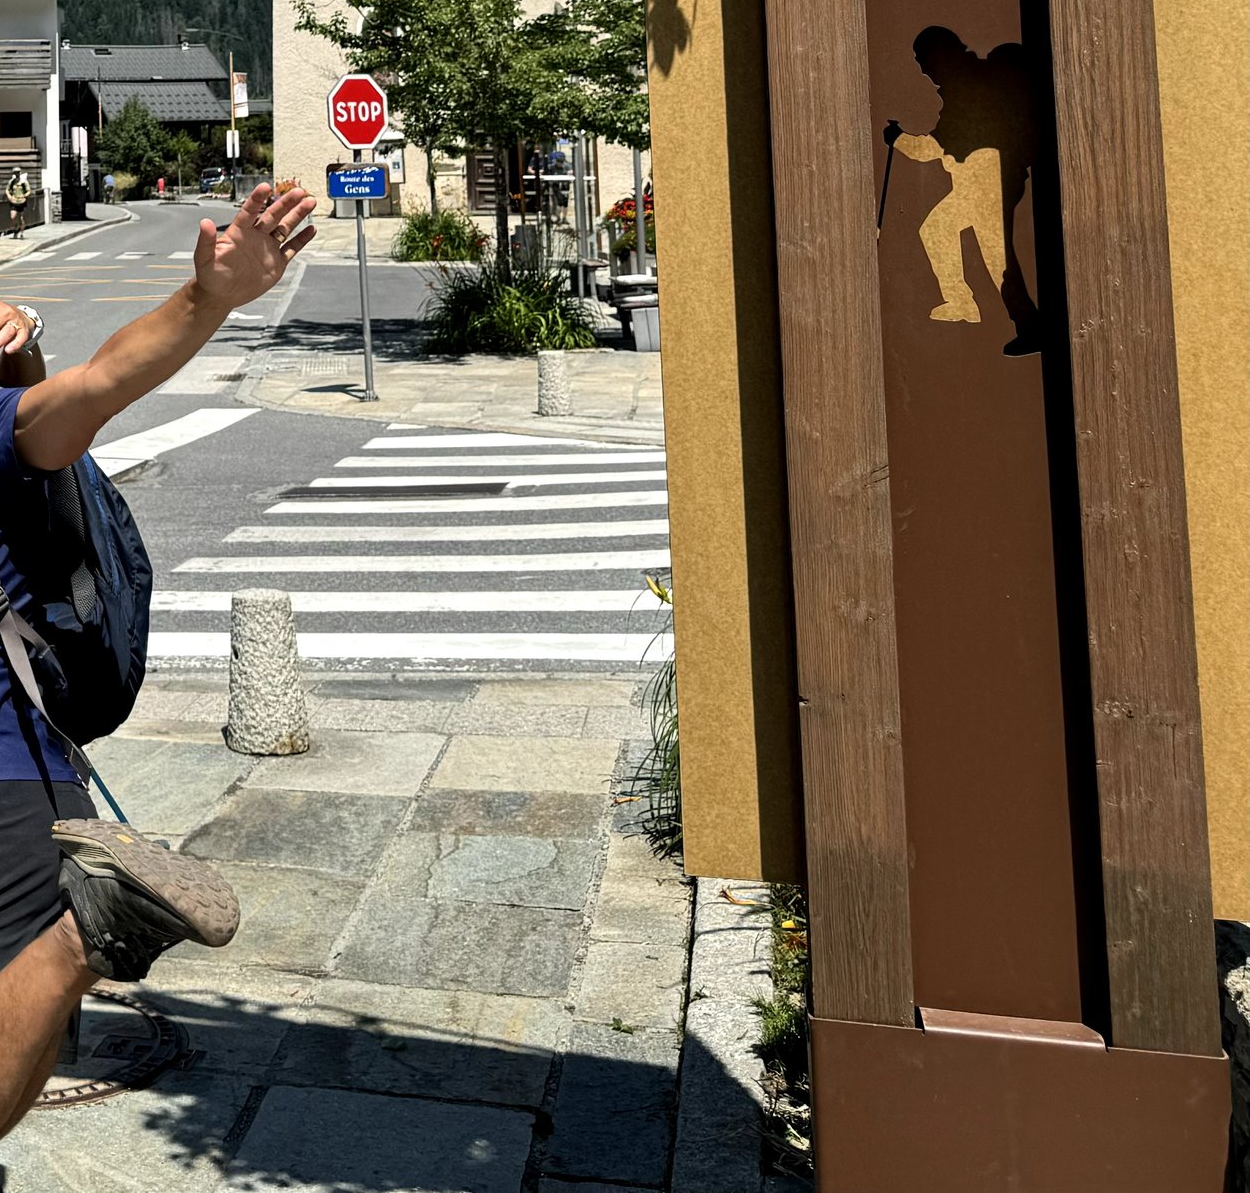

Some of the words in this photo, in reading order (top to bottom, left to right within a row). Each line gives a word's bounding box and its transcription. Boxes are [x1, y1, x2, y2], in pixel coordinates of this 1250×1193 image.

[336, 101, 382, 122] STOP
[340, 175, 360, 183] Route
[361, 174, 375, 183] des
[344, 184, 371, 194] Gens
